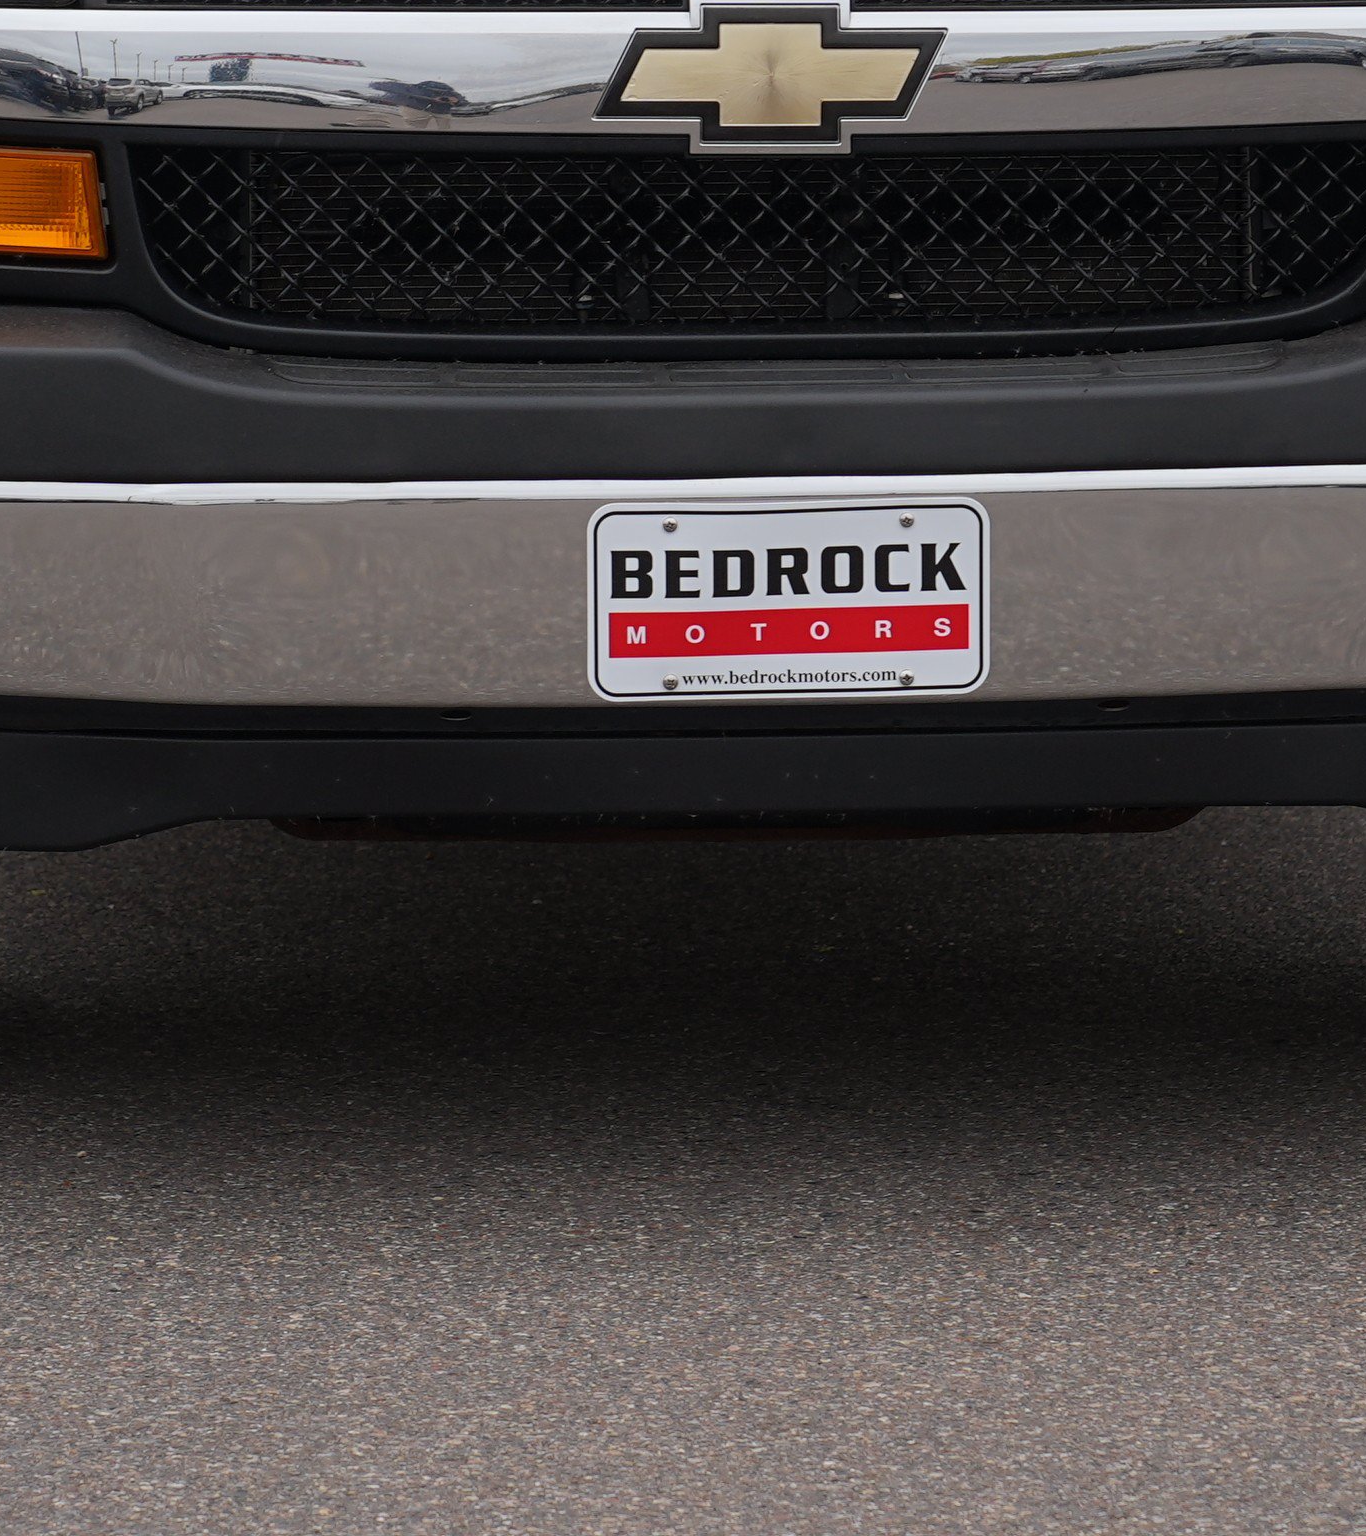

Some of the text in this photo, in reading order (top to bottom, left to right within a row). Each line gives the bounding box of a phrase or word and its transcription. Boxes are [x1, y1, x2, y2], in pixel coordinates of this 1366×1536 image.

[610, 542, 968, 599] BEDROCK
[626, 617, 952, 645] MOTORS
[682, 668, 897, 686] www.bedrockmotors.com
